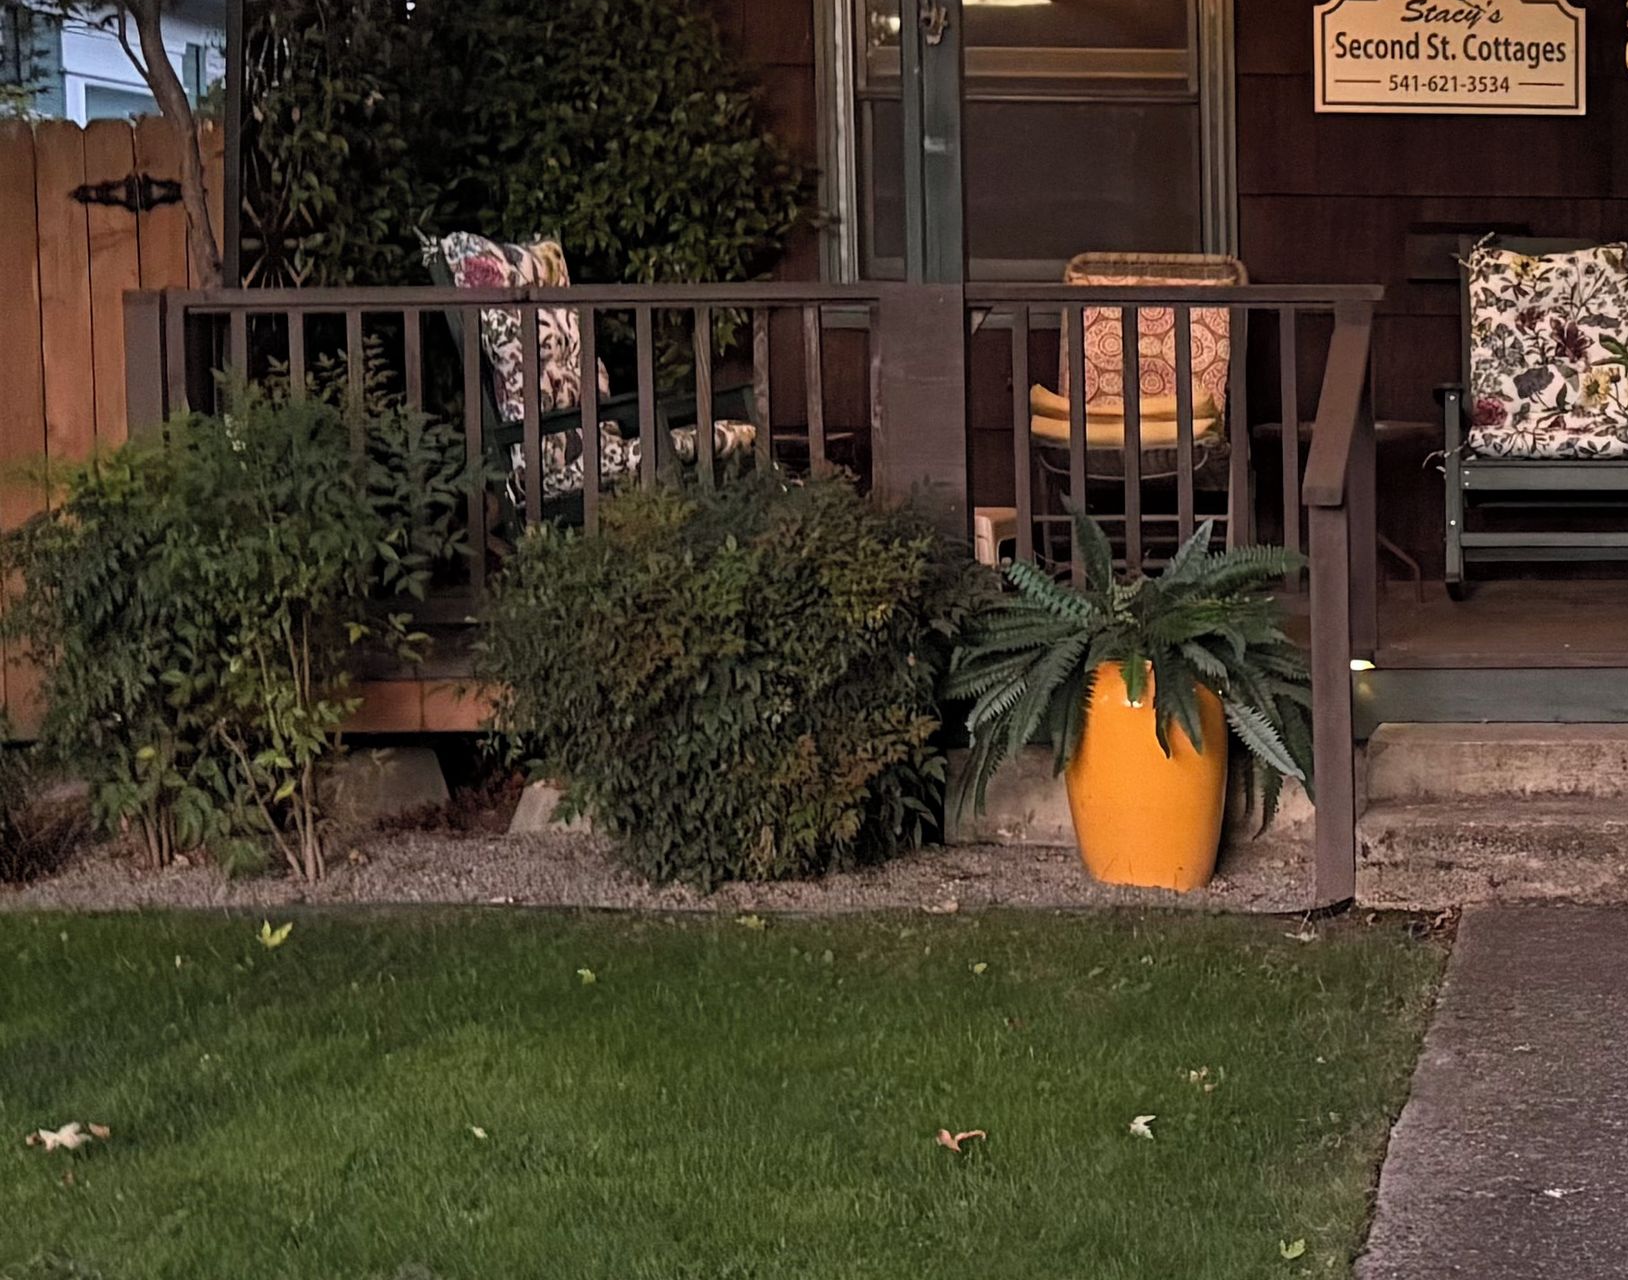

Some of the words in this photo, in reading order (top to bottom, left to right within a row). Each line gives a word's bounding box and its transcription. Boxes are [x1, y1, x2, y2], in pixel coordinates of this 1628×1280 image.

[1335, 32, 1420, 60] Second
[1427, 33, 1457, 61] St.
[1463, 34, 1567, 69] Cottages
[1388, 74, 1510, 94] 541-621-3534
